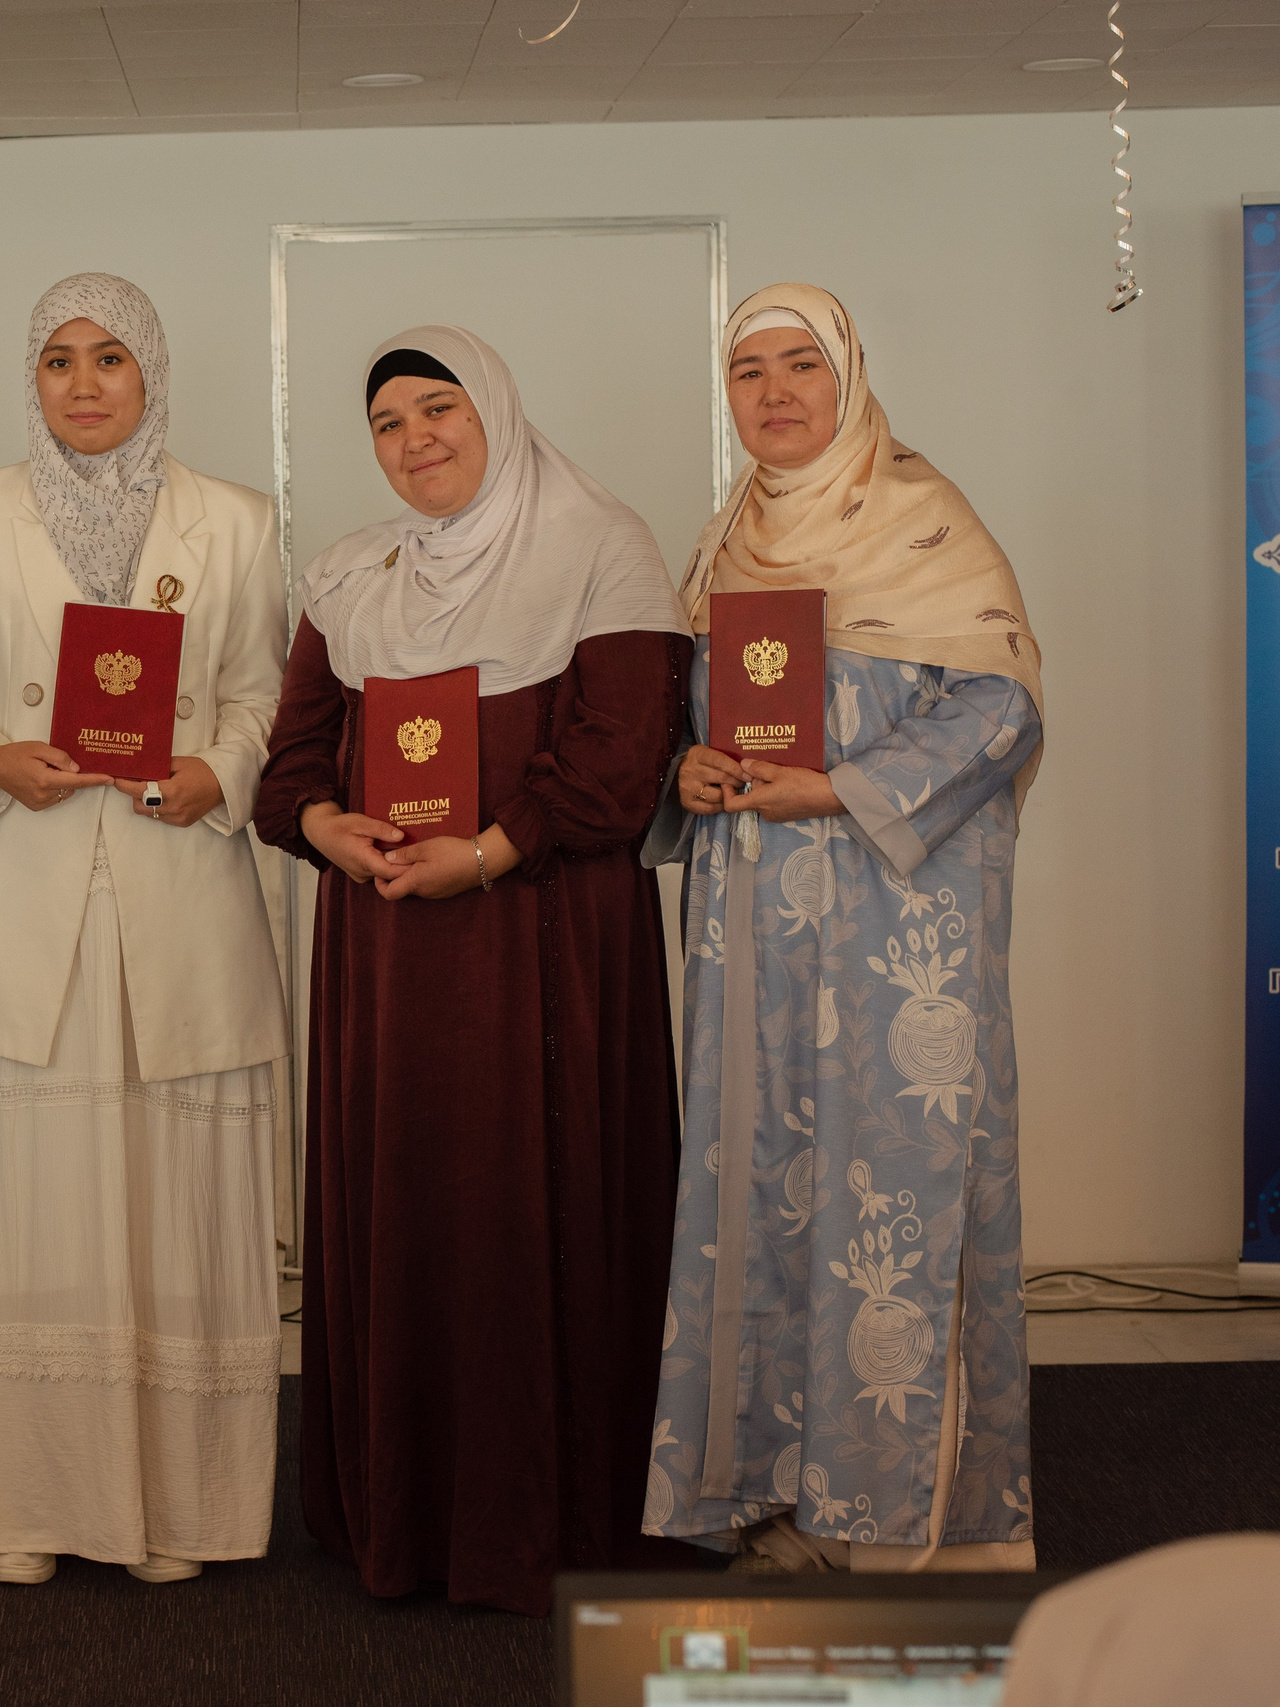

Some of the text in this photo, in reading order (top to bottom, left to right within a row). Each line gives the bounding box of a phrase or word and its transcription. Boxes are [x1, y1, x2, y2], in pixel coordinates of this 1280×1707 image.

[77, 728, 144, 745] ДИПЛОМ
[734, 724, 796, 739] ДИПЛОМ
[740, 736, 795, 744] ПРОФЕССИОНАЛЬНОЙ
[84, 741, 142, 751] ПРОФЕССИОНАЛЬНОЙ
[85, 746, 134, 756] ПЕРЕПОДГОТОВКЕ
[388, 797, 450, 816] ДИПЛОМ
[394, 810, 450, 820] ПРОФЕССИОНАЛЬНОЙ
[396, 817, 443, 826] ПЕРЕПОДГОТОВКЕ
